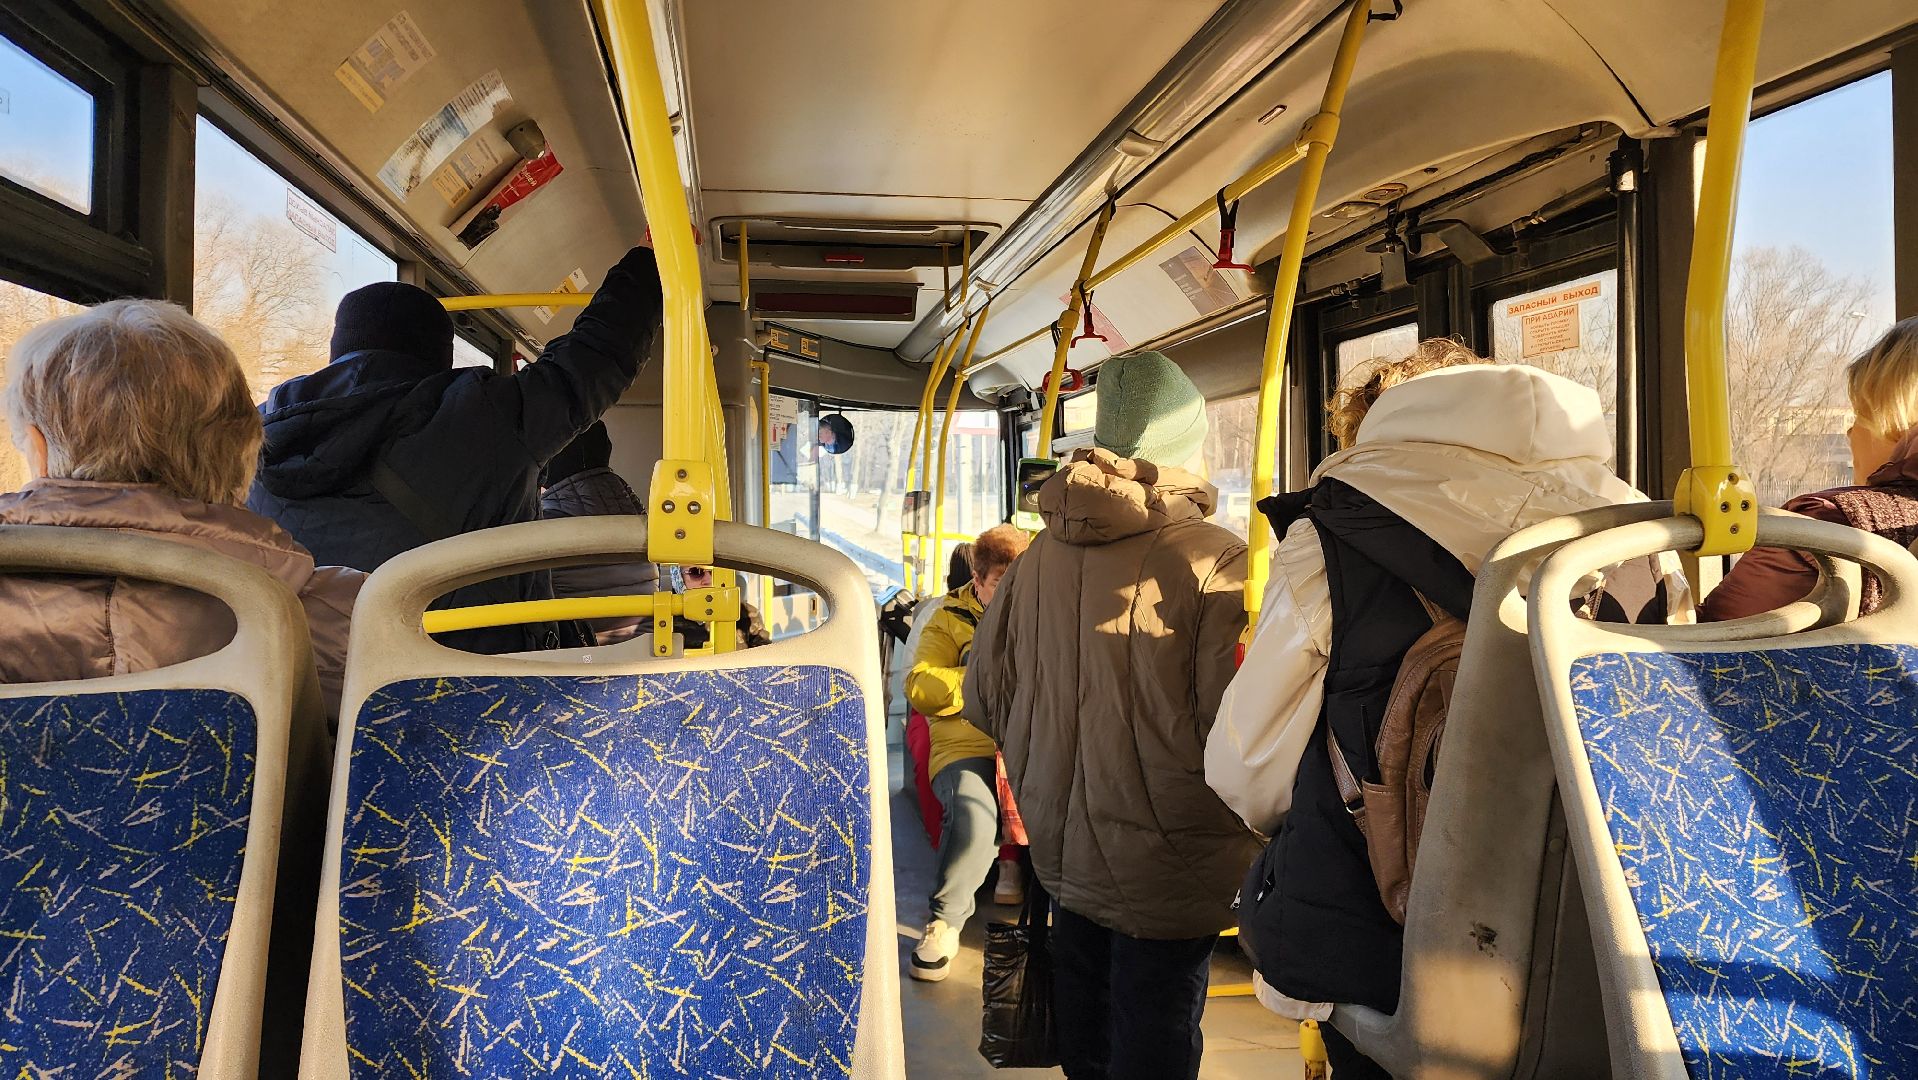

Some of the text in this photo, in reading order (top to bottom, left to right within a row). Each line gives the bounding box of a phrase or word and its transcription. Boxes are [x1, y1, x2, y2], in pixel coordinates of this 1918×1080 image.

[1508, 286, 1599, 315] ЗАПАСНЫЙ ВЫХОД
[1525, 316, 1540, 325] ПРИ
[1542, 307, 1575, 321] АВАРИИ
